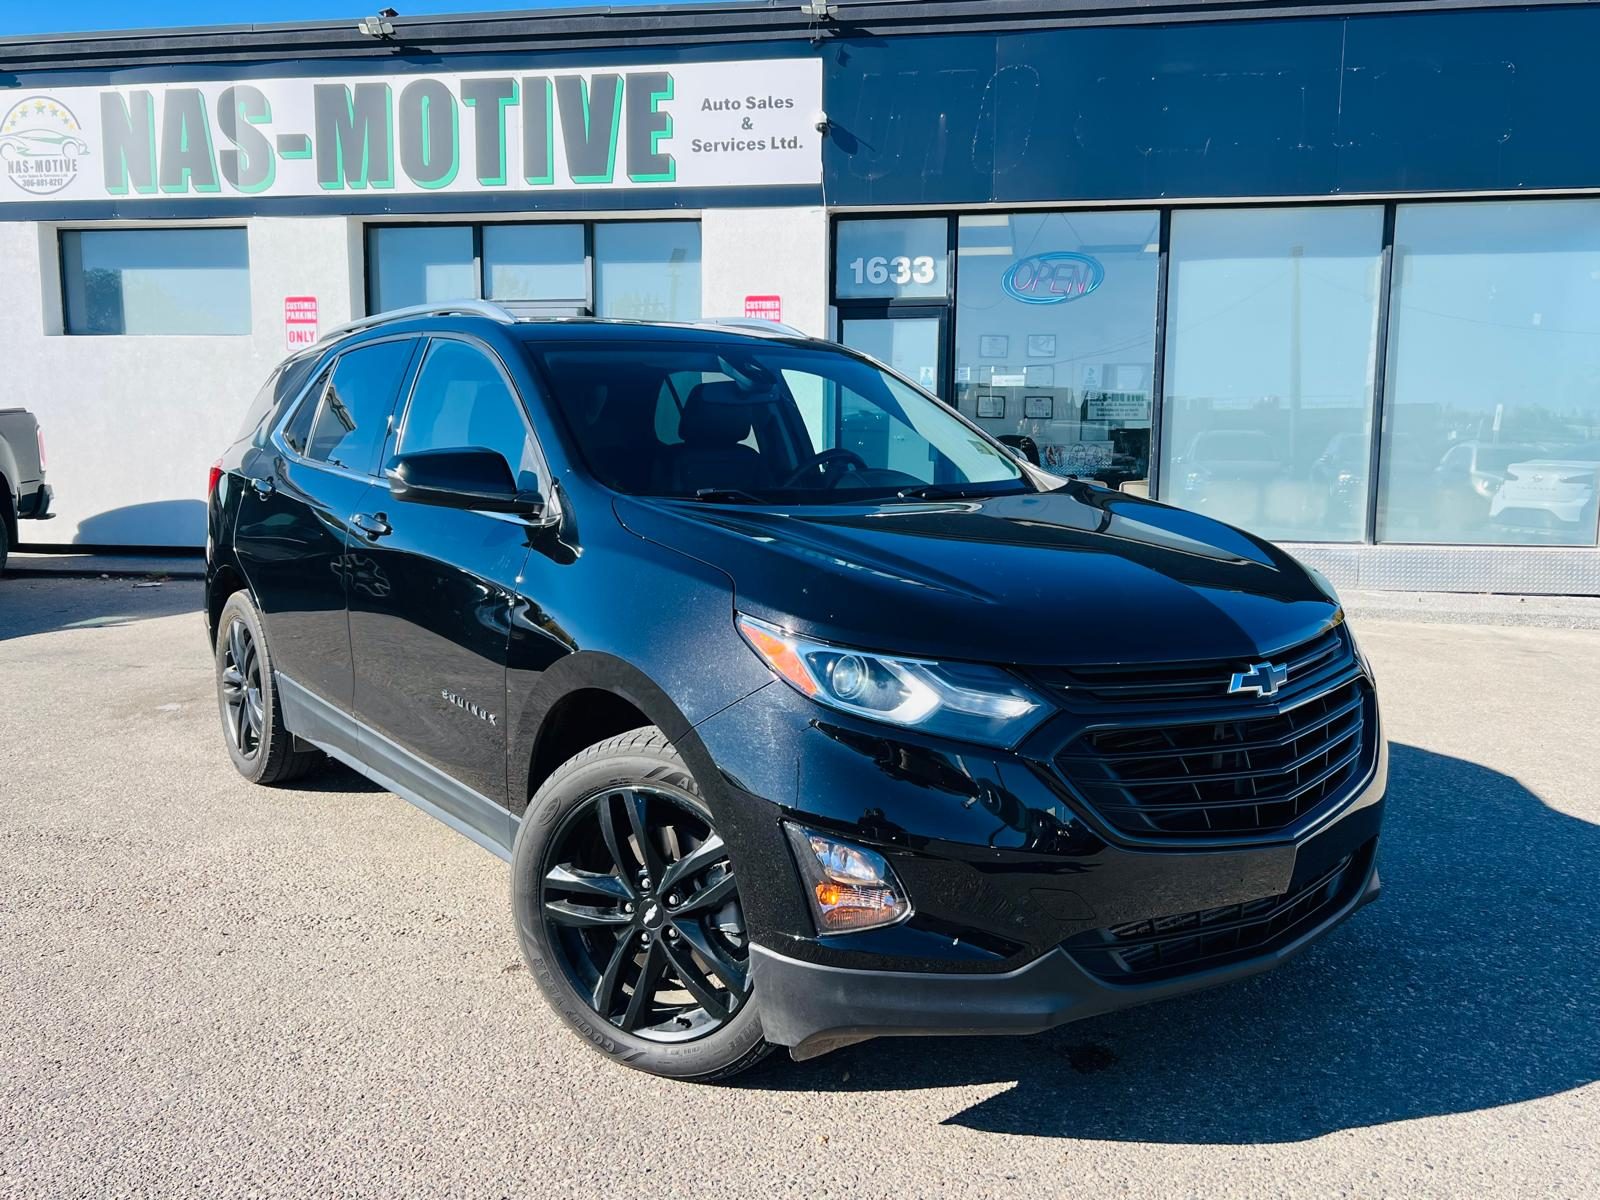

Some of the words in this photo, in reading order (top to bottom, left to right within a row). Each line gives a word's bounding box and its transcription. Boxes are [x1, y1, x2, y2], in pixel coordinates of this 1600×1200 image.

[701, 98, 741, 112] Auto
[745, 95, 795, 110] Sales
[741, 116, 754, 130] &
[100, 72, 676, 196] NAS-MOTIVE
[691, 137, 767, 153] Services
[770, 135, 804, 150] Ltd.
[7, 159, 78, 174] NAS-MOTIVE
[849, 256, 936, 285] 1633
[1013, 261, 1091, 294] OPEN
[286, 311, 317, 320] PARKING
[288, 330, 316, 344] ONLY
